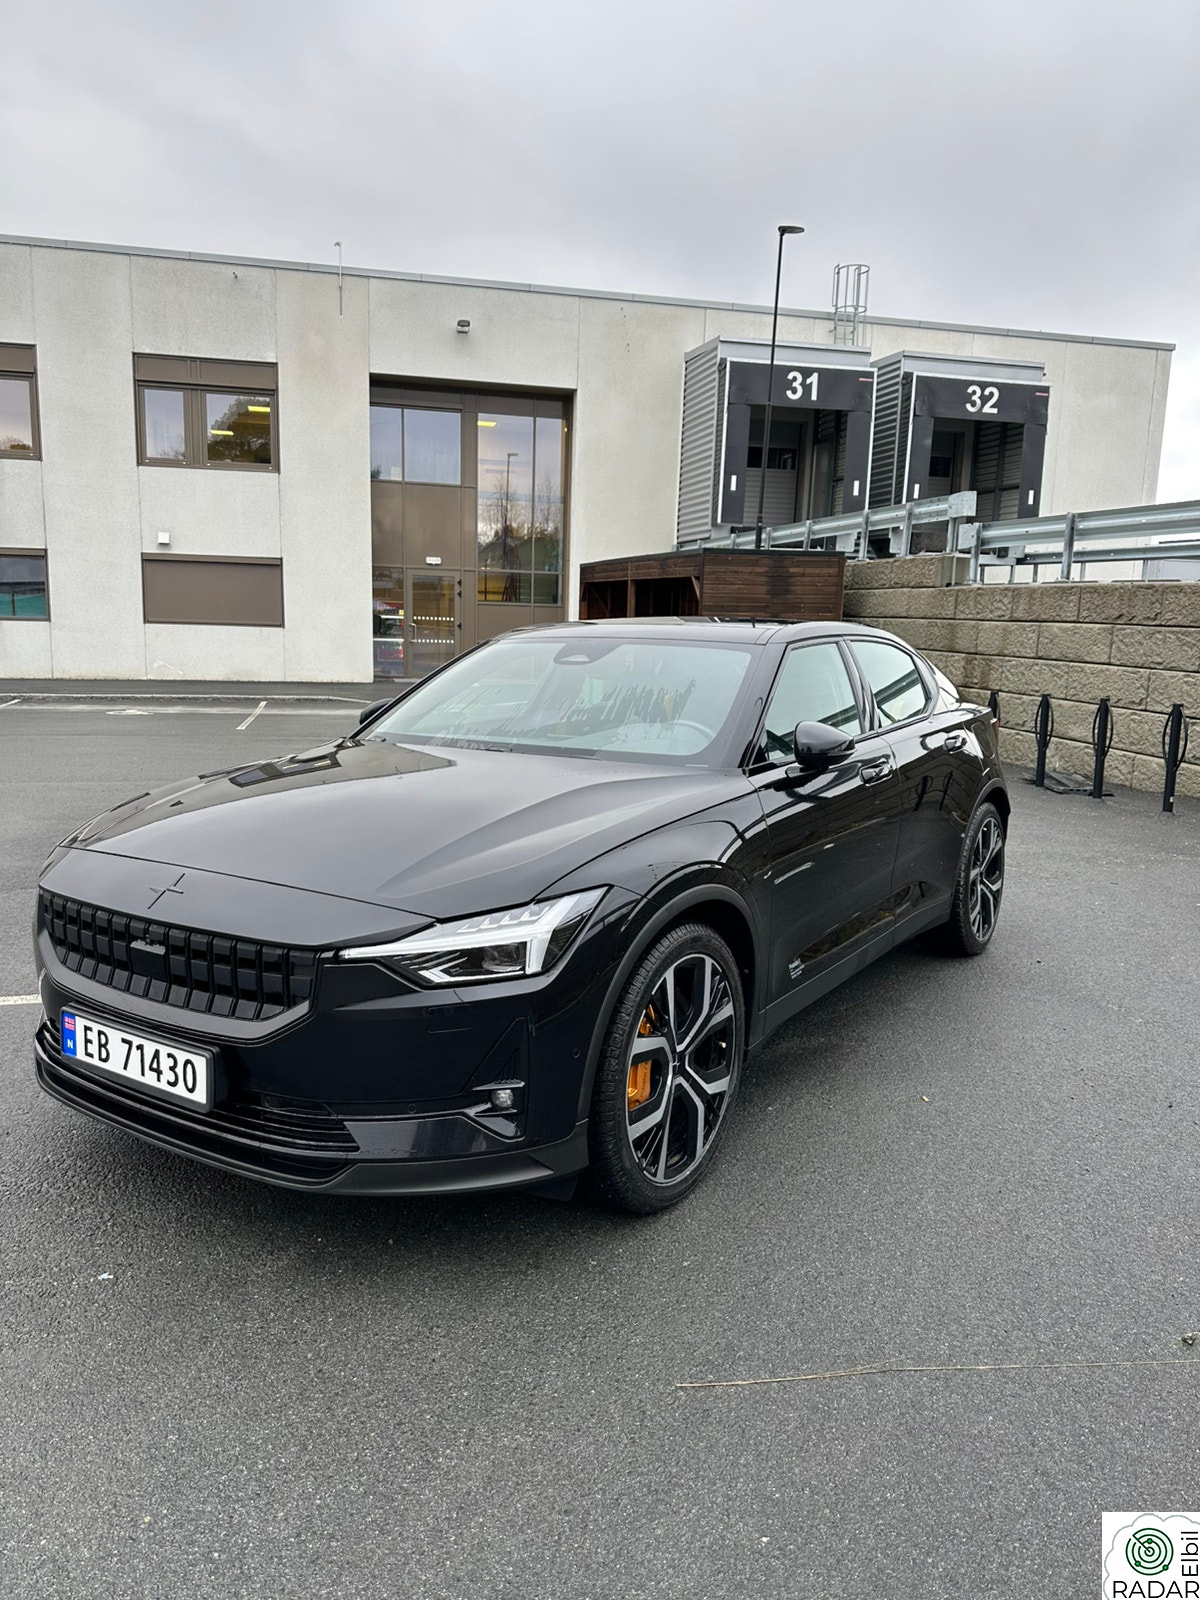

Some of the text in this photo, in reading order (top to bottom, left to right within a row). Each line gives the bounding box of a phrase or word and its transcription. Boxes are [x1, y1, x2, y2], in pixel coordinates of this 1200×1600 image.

[786, 371, 819, 401] 31
[965, 385, 999, 414] 32
[67, 1038, 74, 1049] N
[83, 1024, 197, 1094] EB 71430
